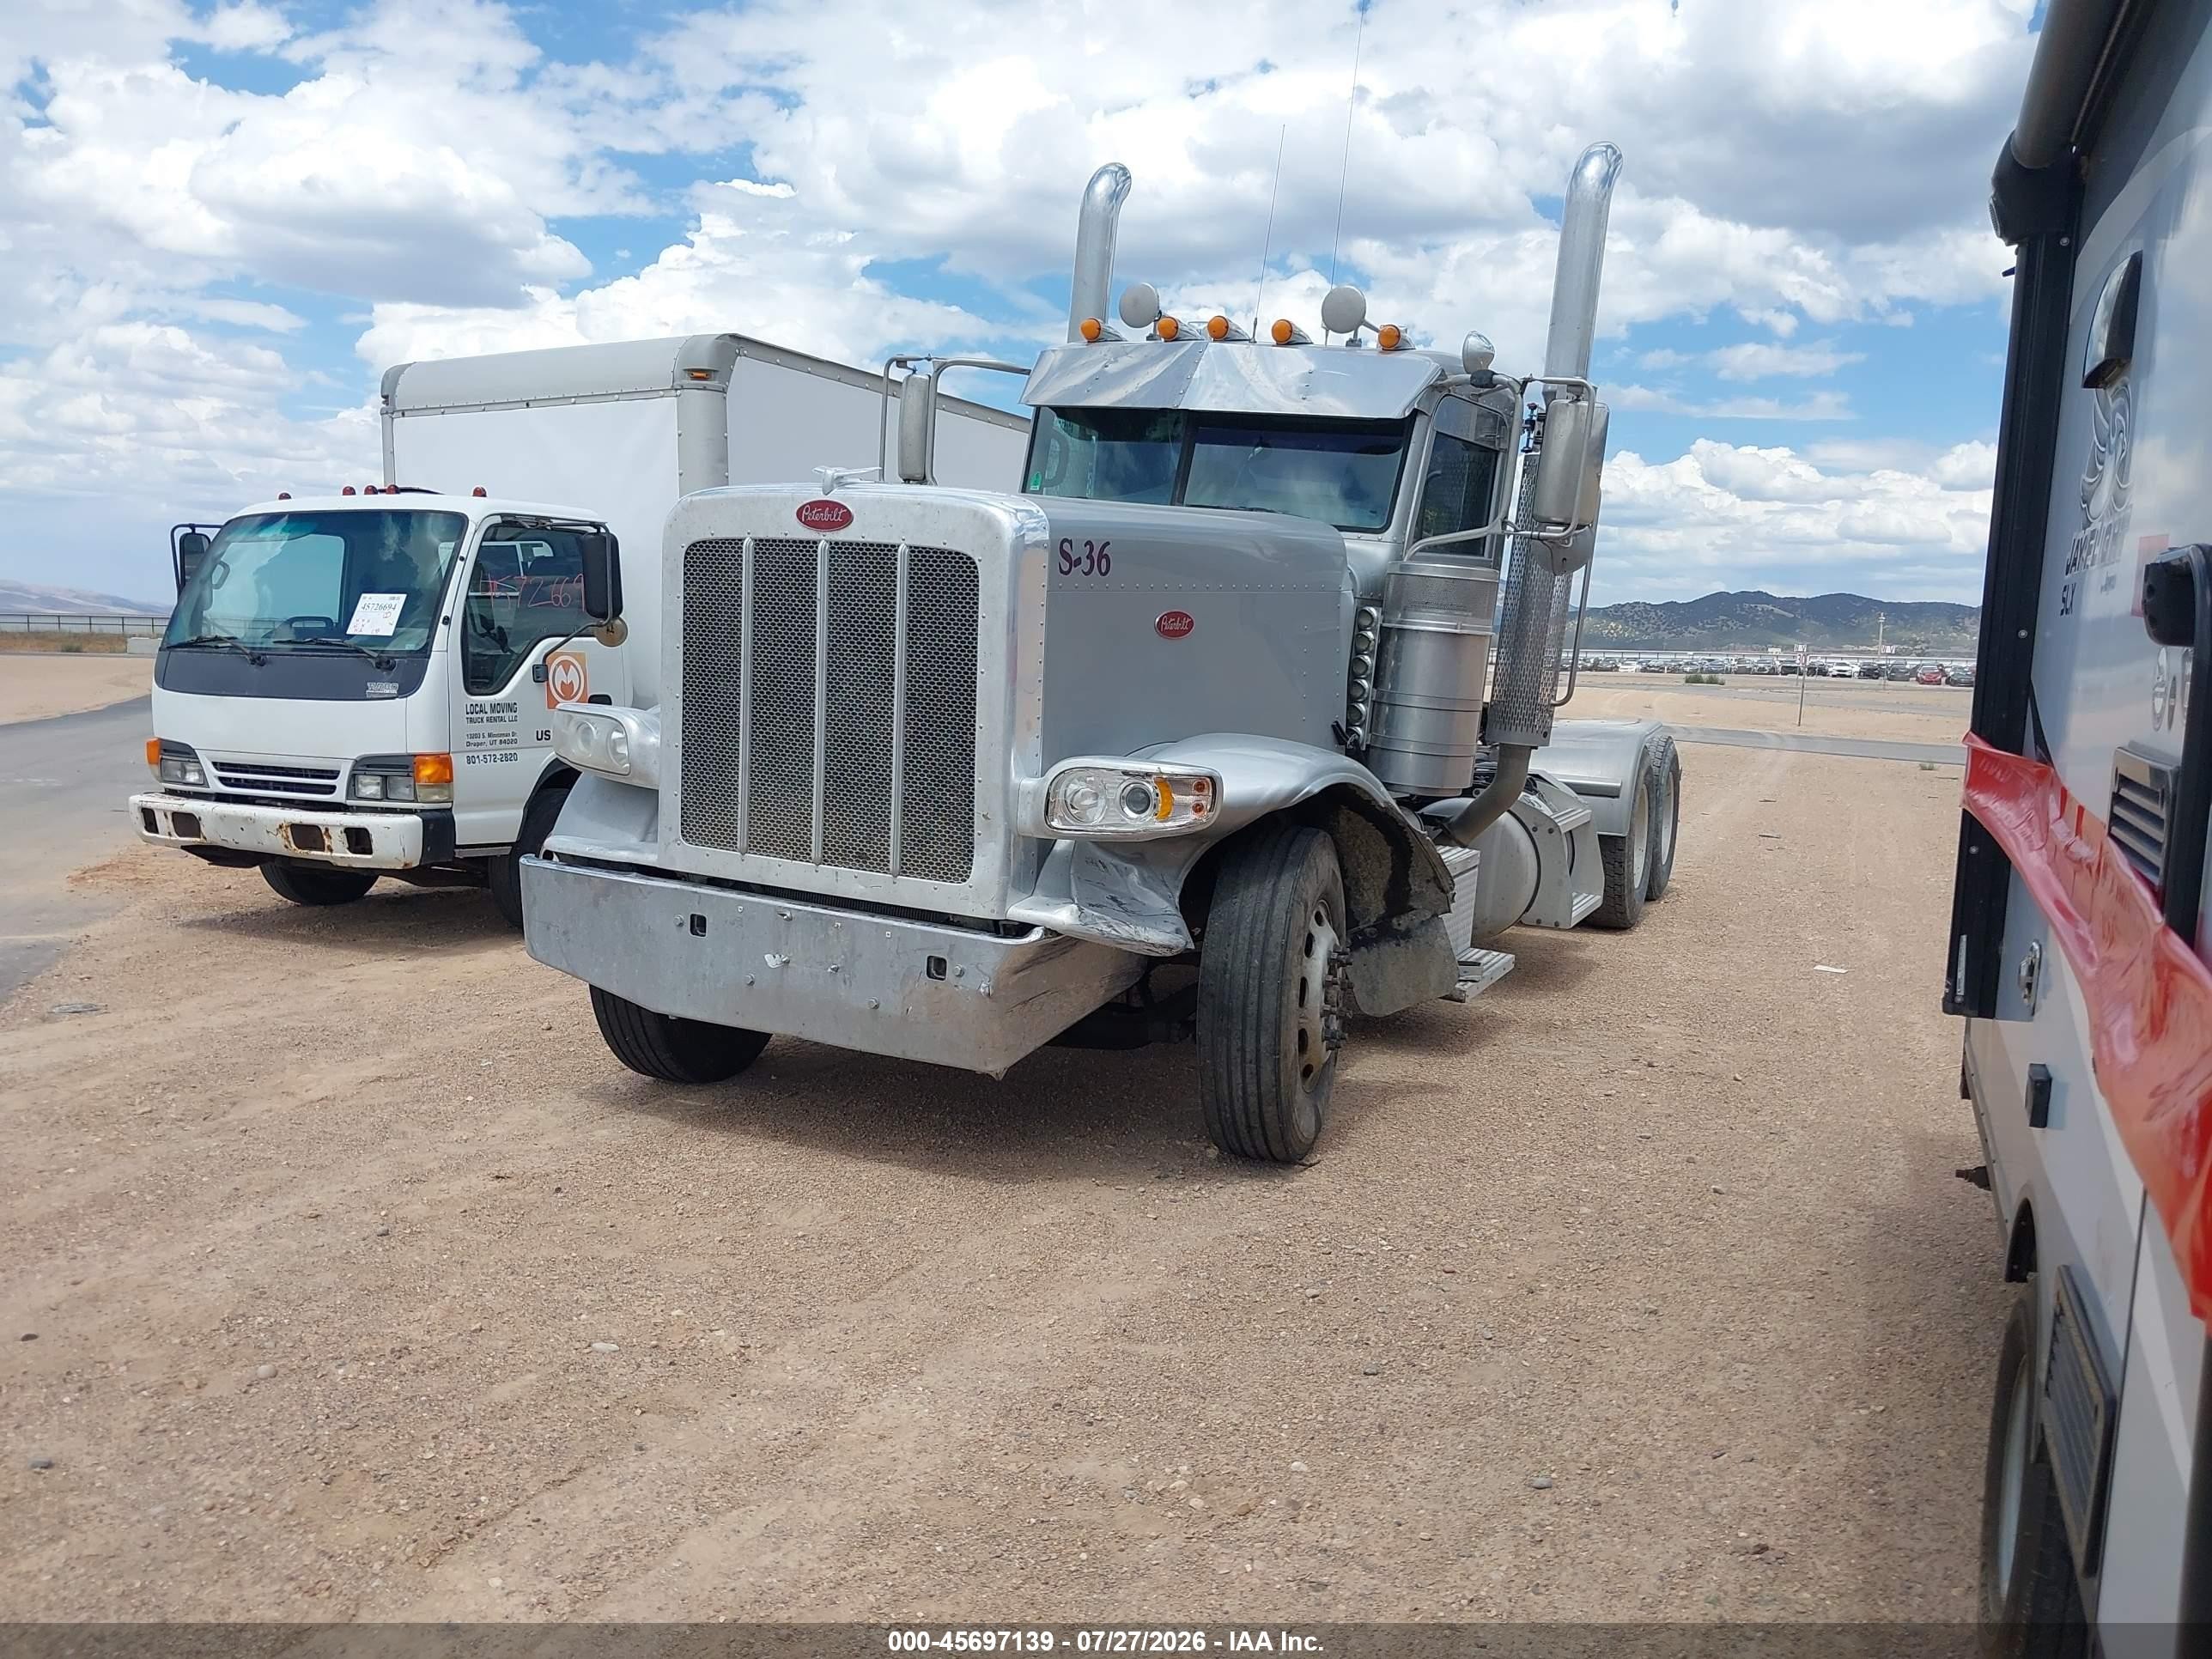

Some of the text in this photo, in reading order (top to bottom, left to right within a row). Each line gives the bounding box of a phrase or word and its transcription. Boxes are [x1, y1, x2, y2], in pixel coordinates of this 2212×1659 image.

[801, 504, 848, 522] Peterbilt
[1058, 538, 1111, 577] S-36
[1160, 615, 1192, 632] Peterbilt
[465, 702, 518, 714] LOCAL MOVING
[536, 730, 551, 741] US
[466, 752, 519, 764] 801-572-2820
